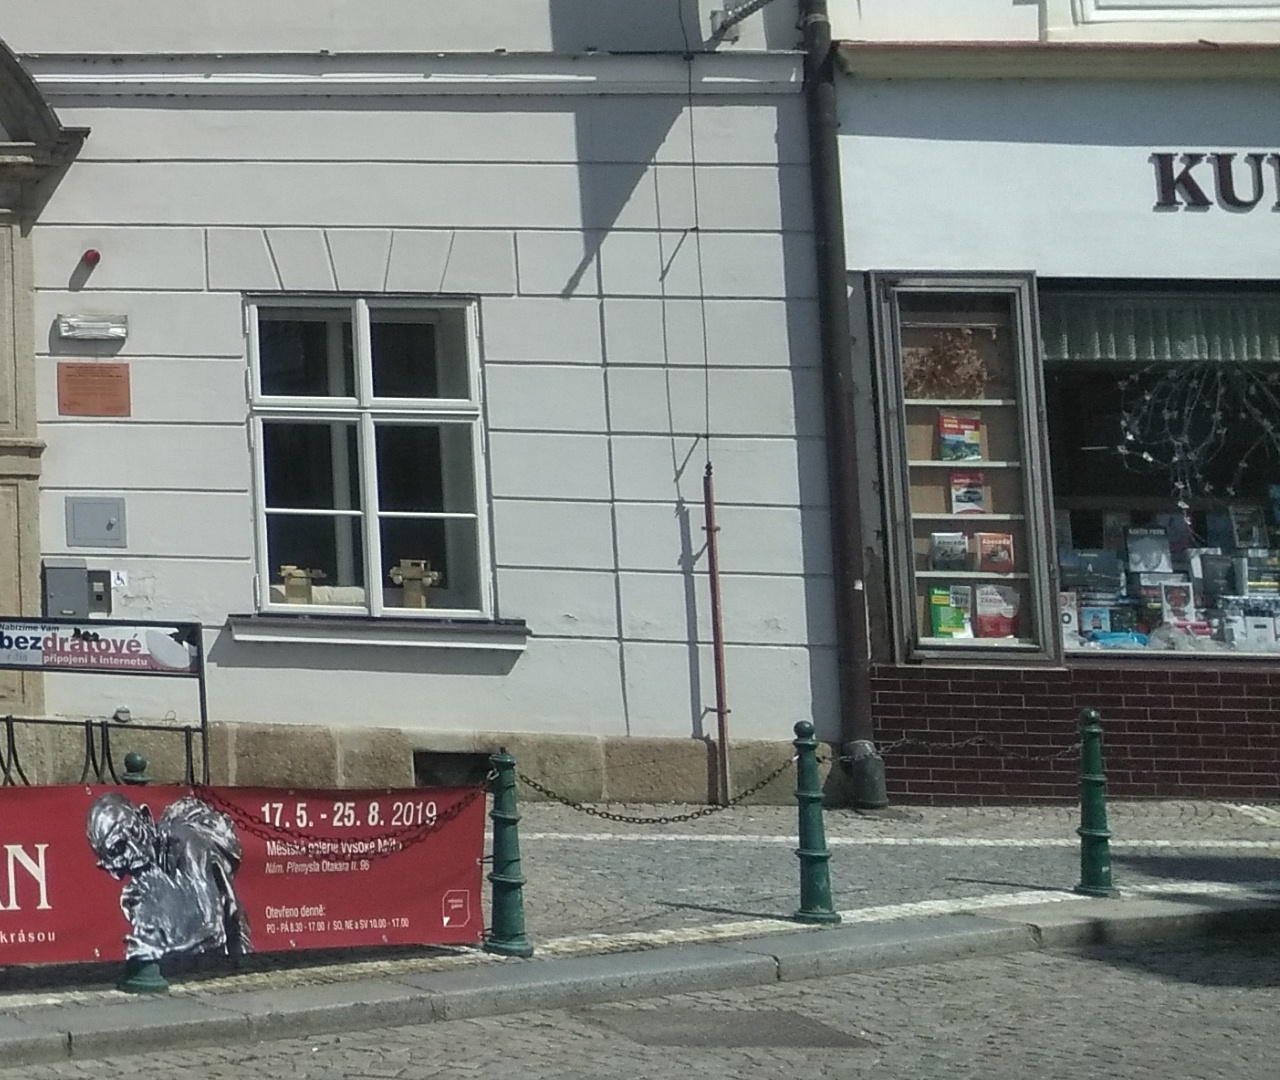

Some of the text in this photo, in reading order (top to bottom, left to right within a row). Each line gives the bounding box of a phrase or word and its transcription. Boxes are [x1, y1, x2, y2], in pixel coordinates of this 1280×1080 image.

[90, 654, 97, 664] k
[99, 655, 148, 666] internetu
[261, 802, 290, 828] 17.
[296, 802, 314, 828] 5.
[332, 801, 361, 827] 25.
[368, 801, 385, 827] 8.
[391, 801, 437, 826] 2019
[360, 859, 370, 871] 96
[266, 923, 276, 934] PO
[0, 929, 56, 944] krásou
